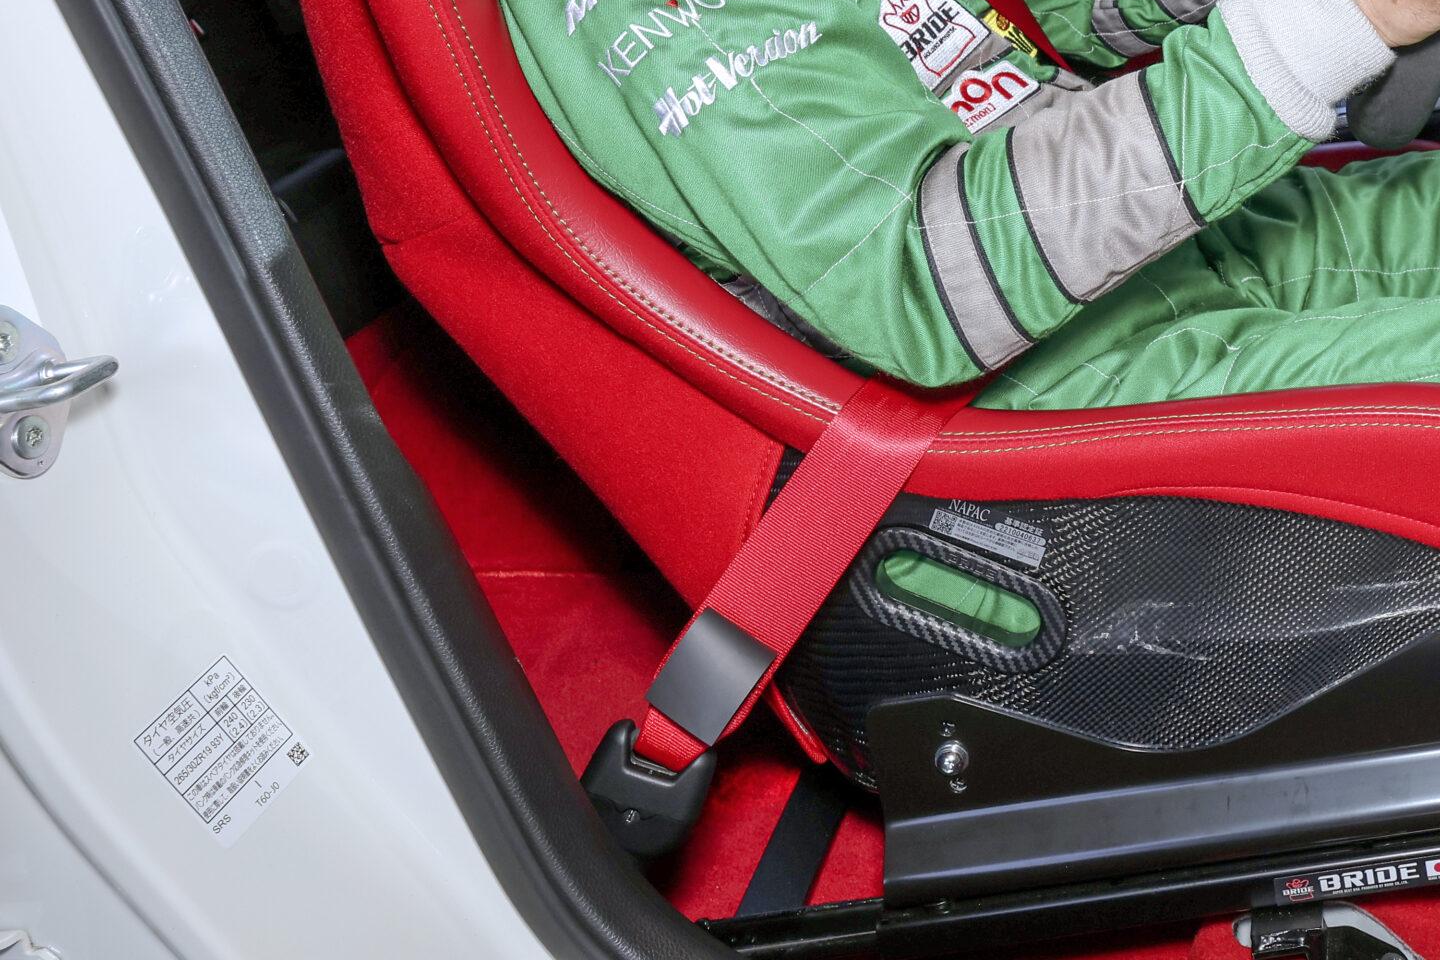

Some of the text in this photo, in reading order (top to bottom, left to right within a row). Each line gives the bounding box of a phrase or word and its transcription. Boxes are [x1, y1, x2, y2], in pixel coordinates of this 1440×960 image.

[948, 499, 991, 522] NAPAC
[203, 672, 220, 687] kPa
[241, 695, 256, 711] 230
[143, 697, 194, 747] タイヤ空気圧
[223, 712, 239, 728] 240
[173, 732, 225, 786] 265/30ZR19 93Y
[212, 814, 232, 834] SRS
[1318, 862, 1420, 892] BRIDE
